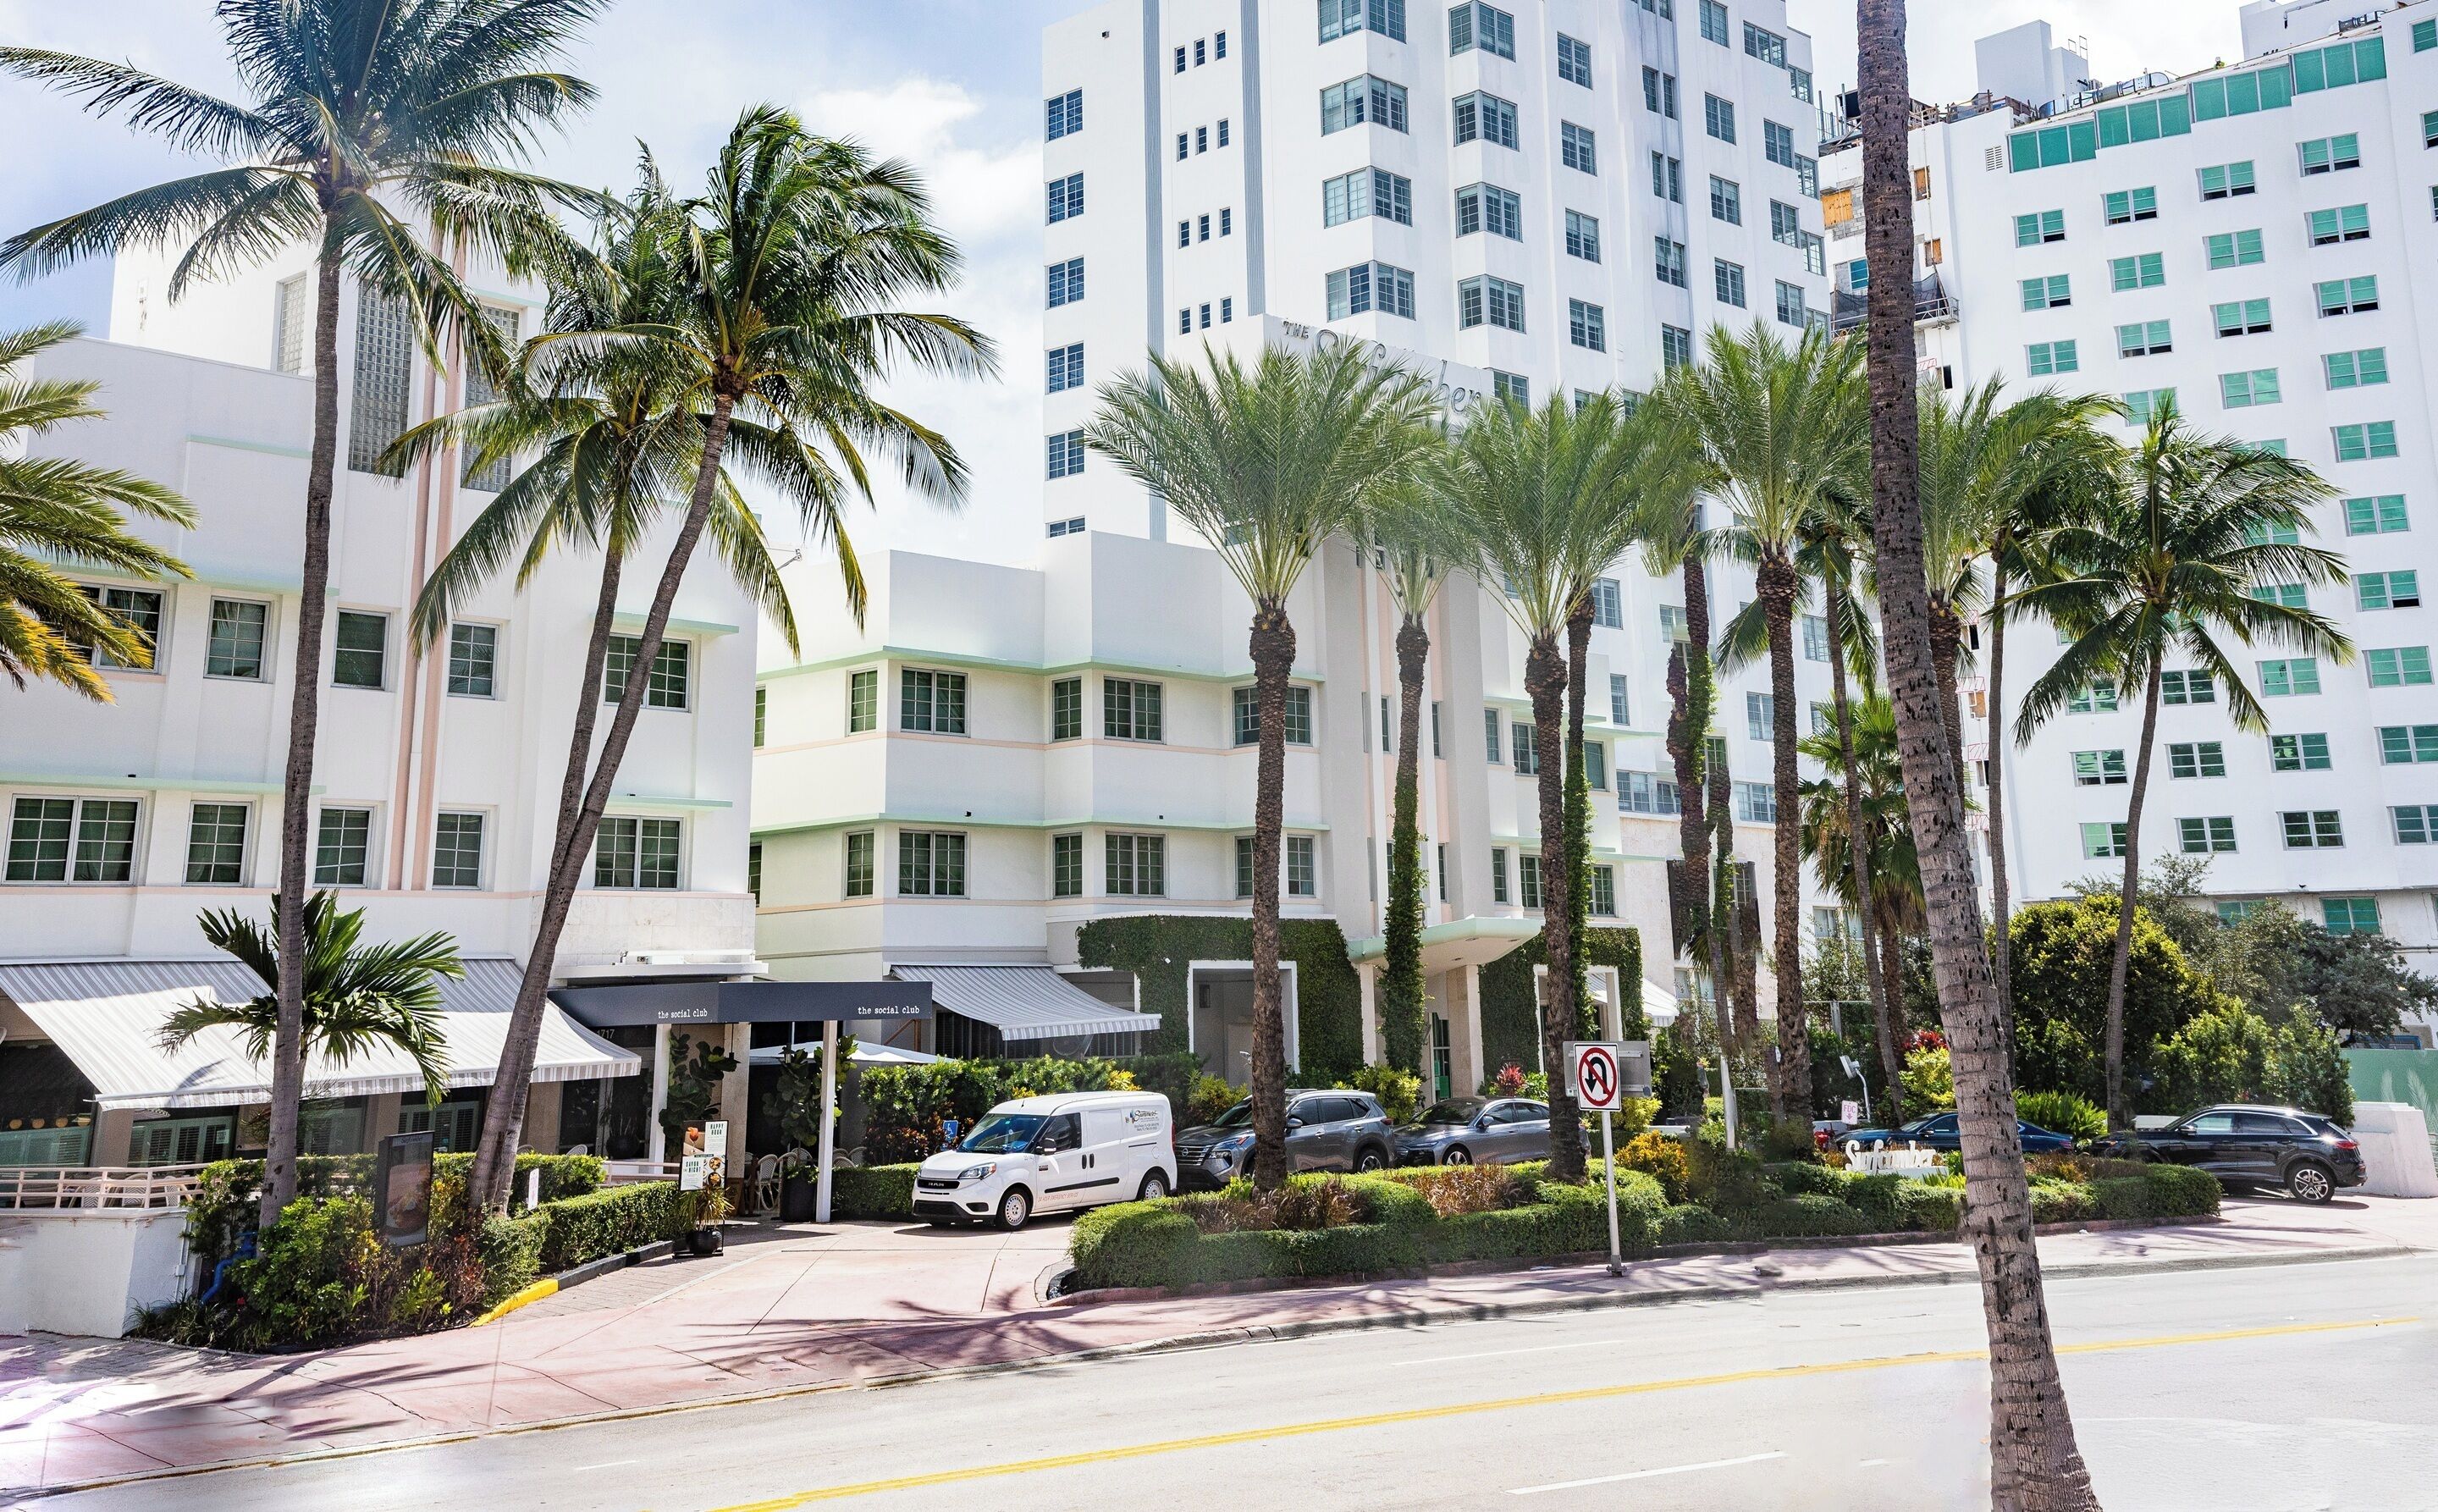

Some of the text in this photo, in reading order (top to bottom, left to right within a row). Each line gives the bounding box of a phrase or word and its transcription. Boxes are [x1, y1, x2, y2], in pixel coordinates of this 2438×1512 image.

[1282, 321, 1309, 339] THE
[658, 1008, 708, 1019] the social club
[858, 1006, 920, 1015] the social club
[597, 1029, 615, 1039] 1717
[1843, 1104, 1856, 1113] FDC
[1845, 1139, 1937, 1174] Surfcomber
